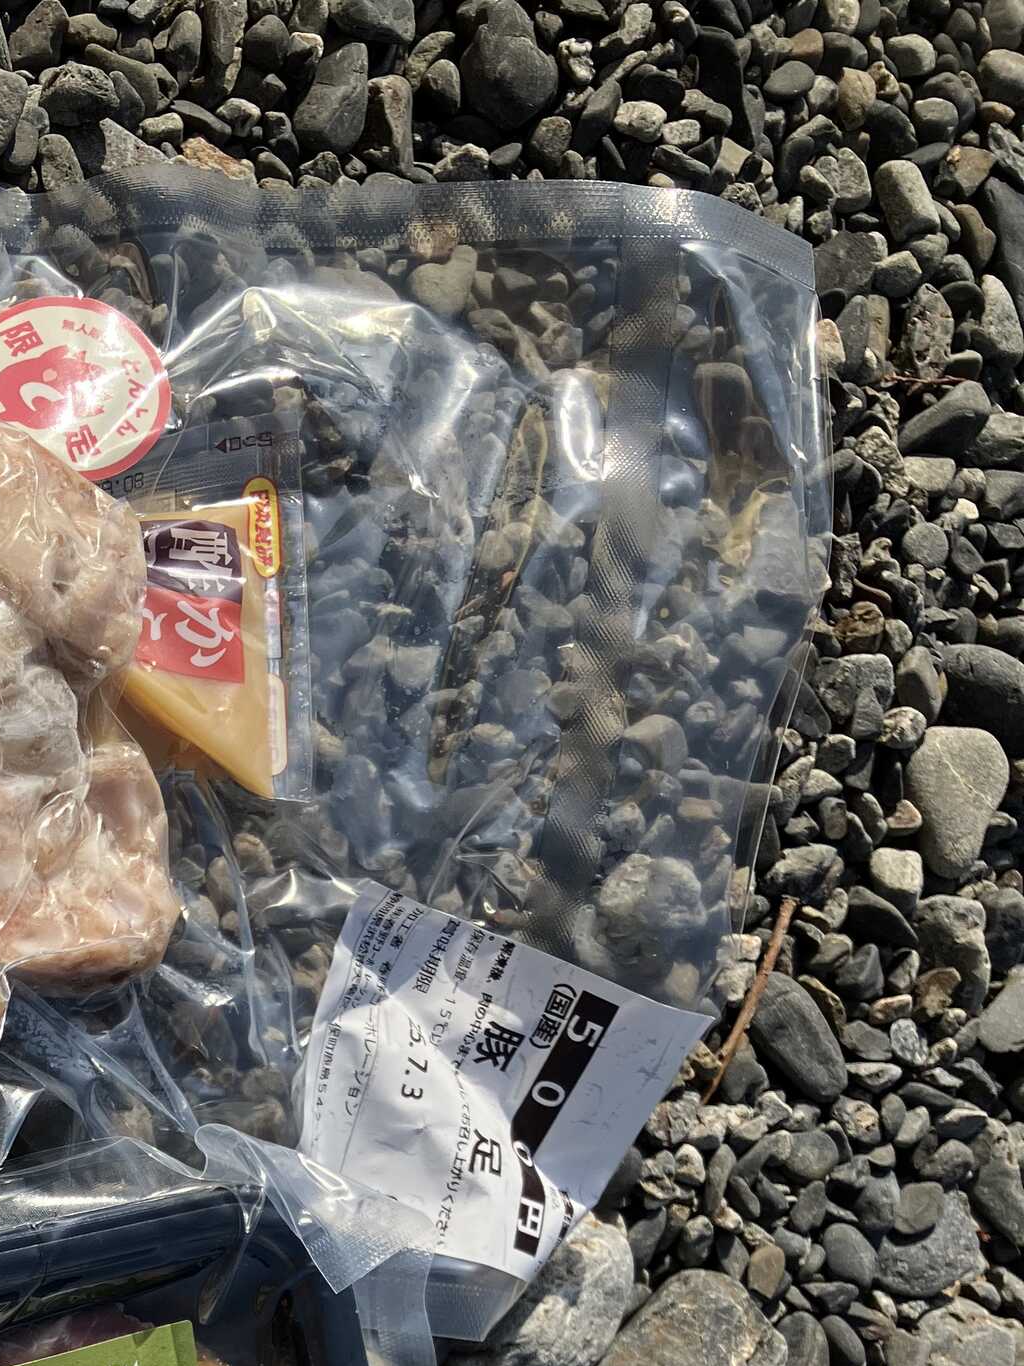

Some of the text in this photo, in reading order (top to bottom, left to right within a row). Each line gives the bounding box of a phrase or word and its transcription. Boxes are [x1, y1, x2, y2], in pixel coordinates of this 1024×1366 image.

[528, 981, 577, 1049] (国産)
[468, 1020, 527, 1178] 豚 足
